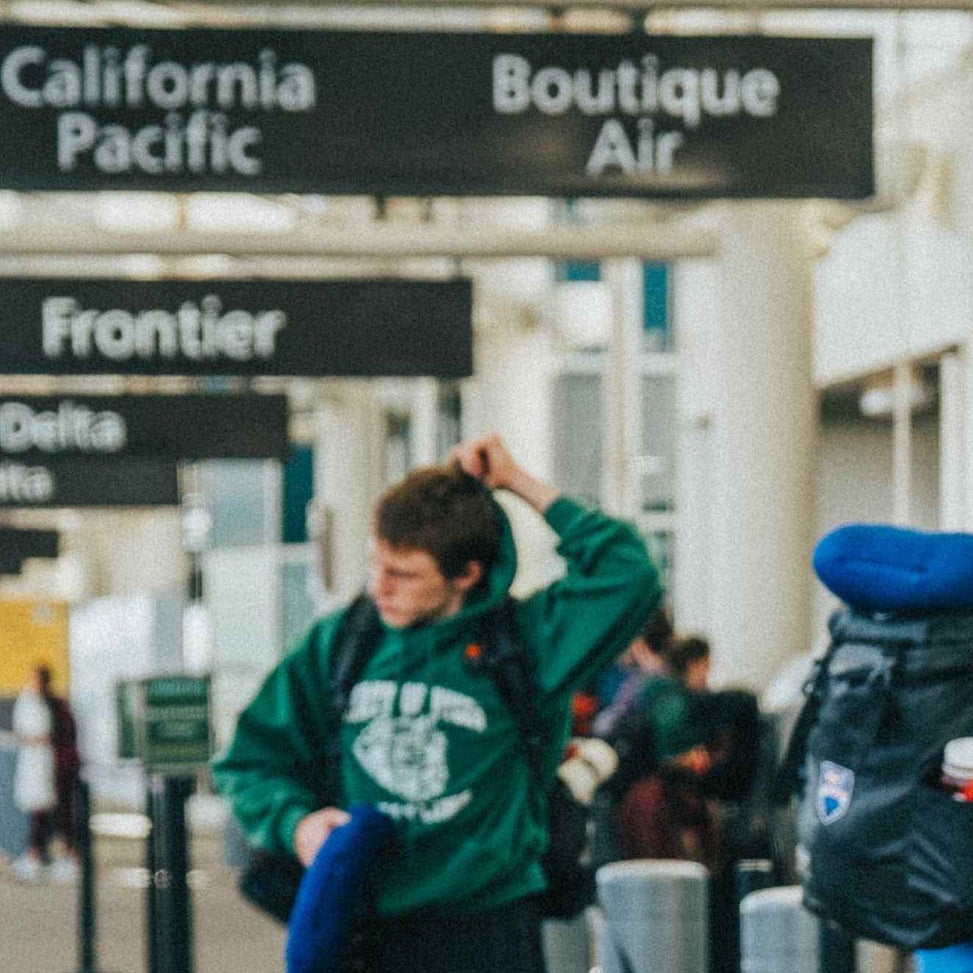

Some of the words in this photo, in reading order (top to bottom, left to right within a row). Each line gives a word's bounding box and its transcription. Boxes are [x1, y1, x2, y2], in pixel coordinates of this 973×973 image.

[1, 45, 316, 109] California
[492, 54, 782, 125] Boutique
[57, 111, 263, 175] Pacific
[586, 118, 684, 175] Air
[42, 295, 287, 360] Frontier
[0, 400, 128, 452] Delta
